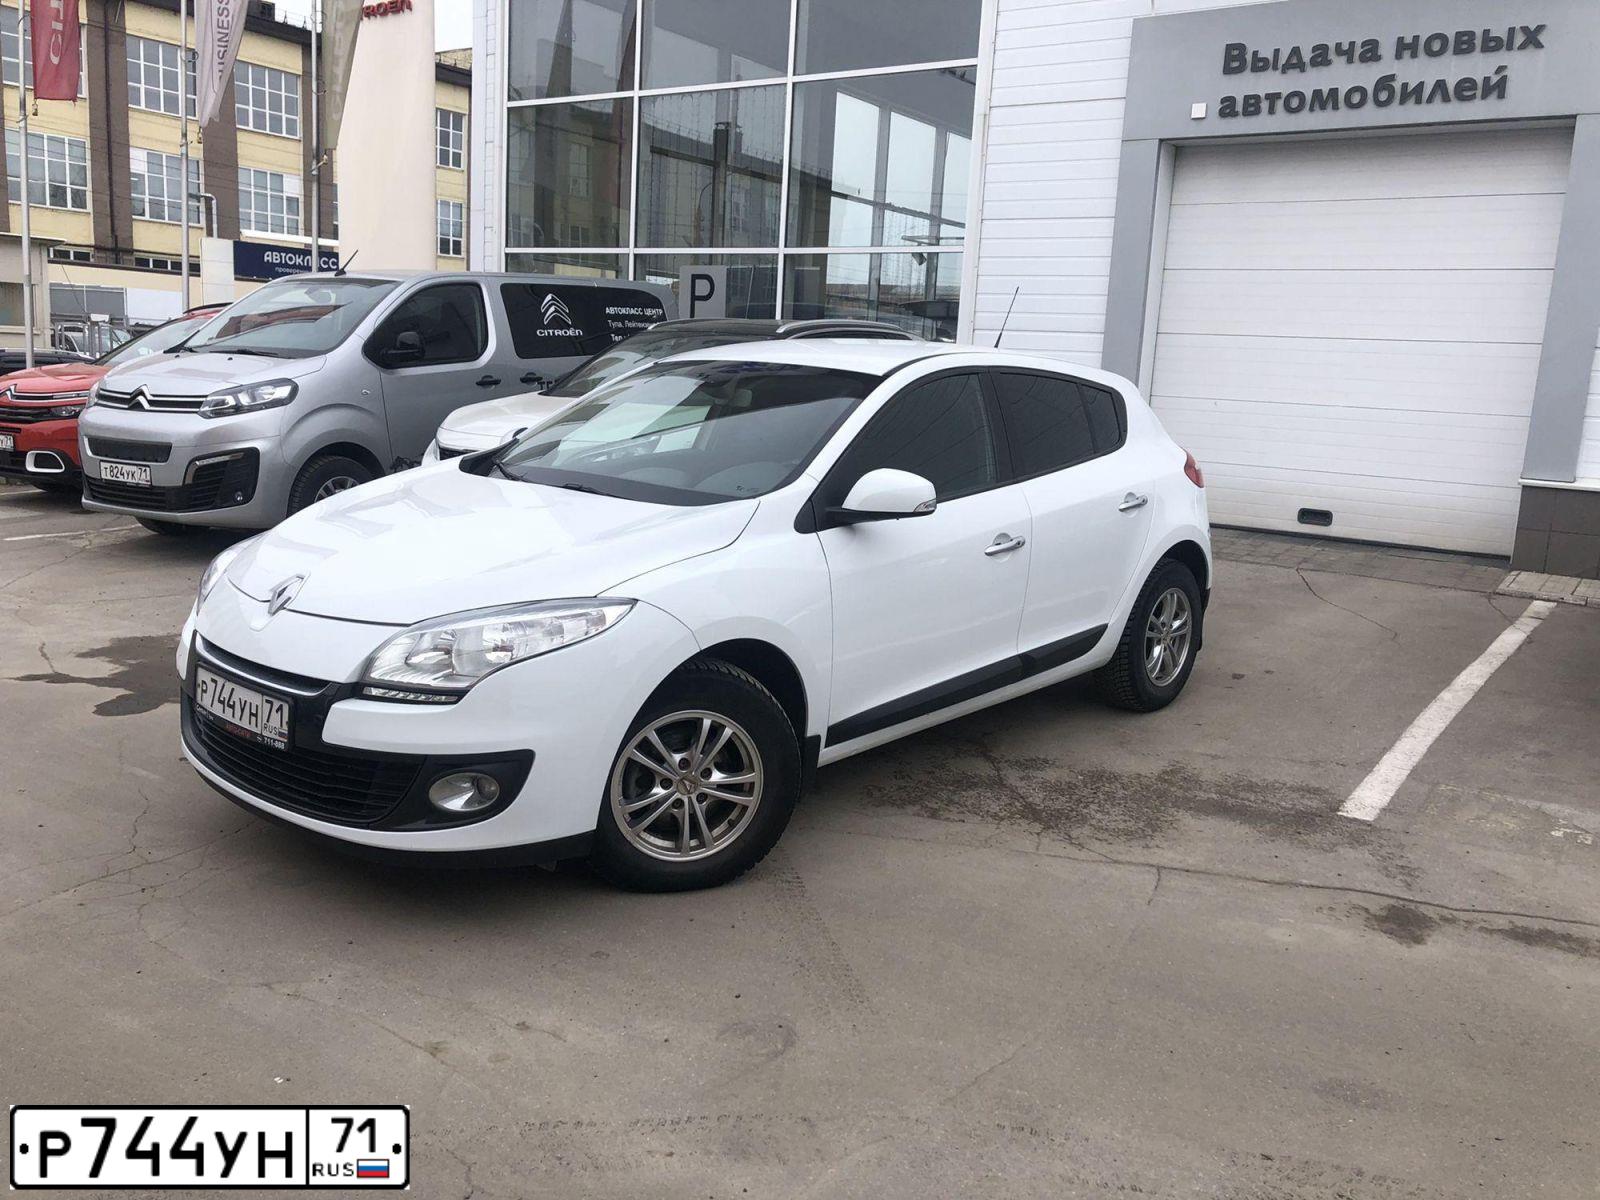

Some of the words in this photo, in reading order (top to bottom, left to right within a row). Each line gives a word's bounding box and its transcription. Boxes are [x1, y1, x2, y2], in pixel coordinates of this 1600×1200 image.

[1222, 38, 1382, 75] Выдача
[1394, 23, 1546, 60] новых
[1218, 64, 1510, 118] автомобилей
[264, 251, 338, 269] АВТОКЛСС
[605, 306, 643, 315] АВТОКЛАСС
[200, 677, 259, 728] Р744УН
[265, 699, 284, 728] 71
[263, 722, 278, 736] RUS
